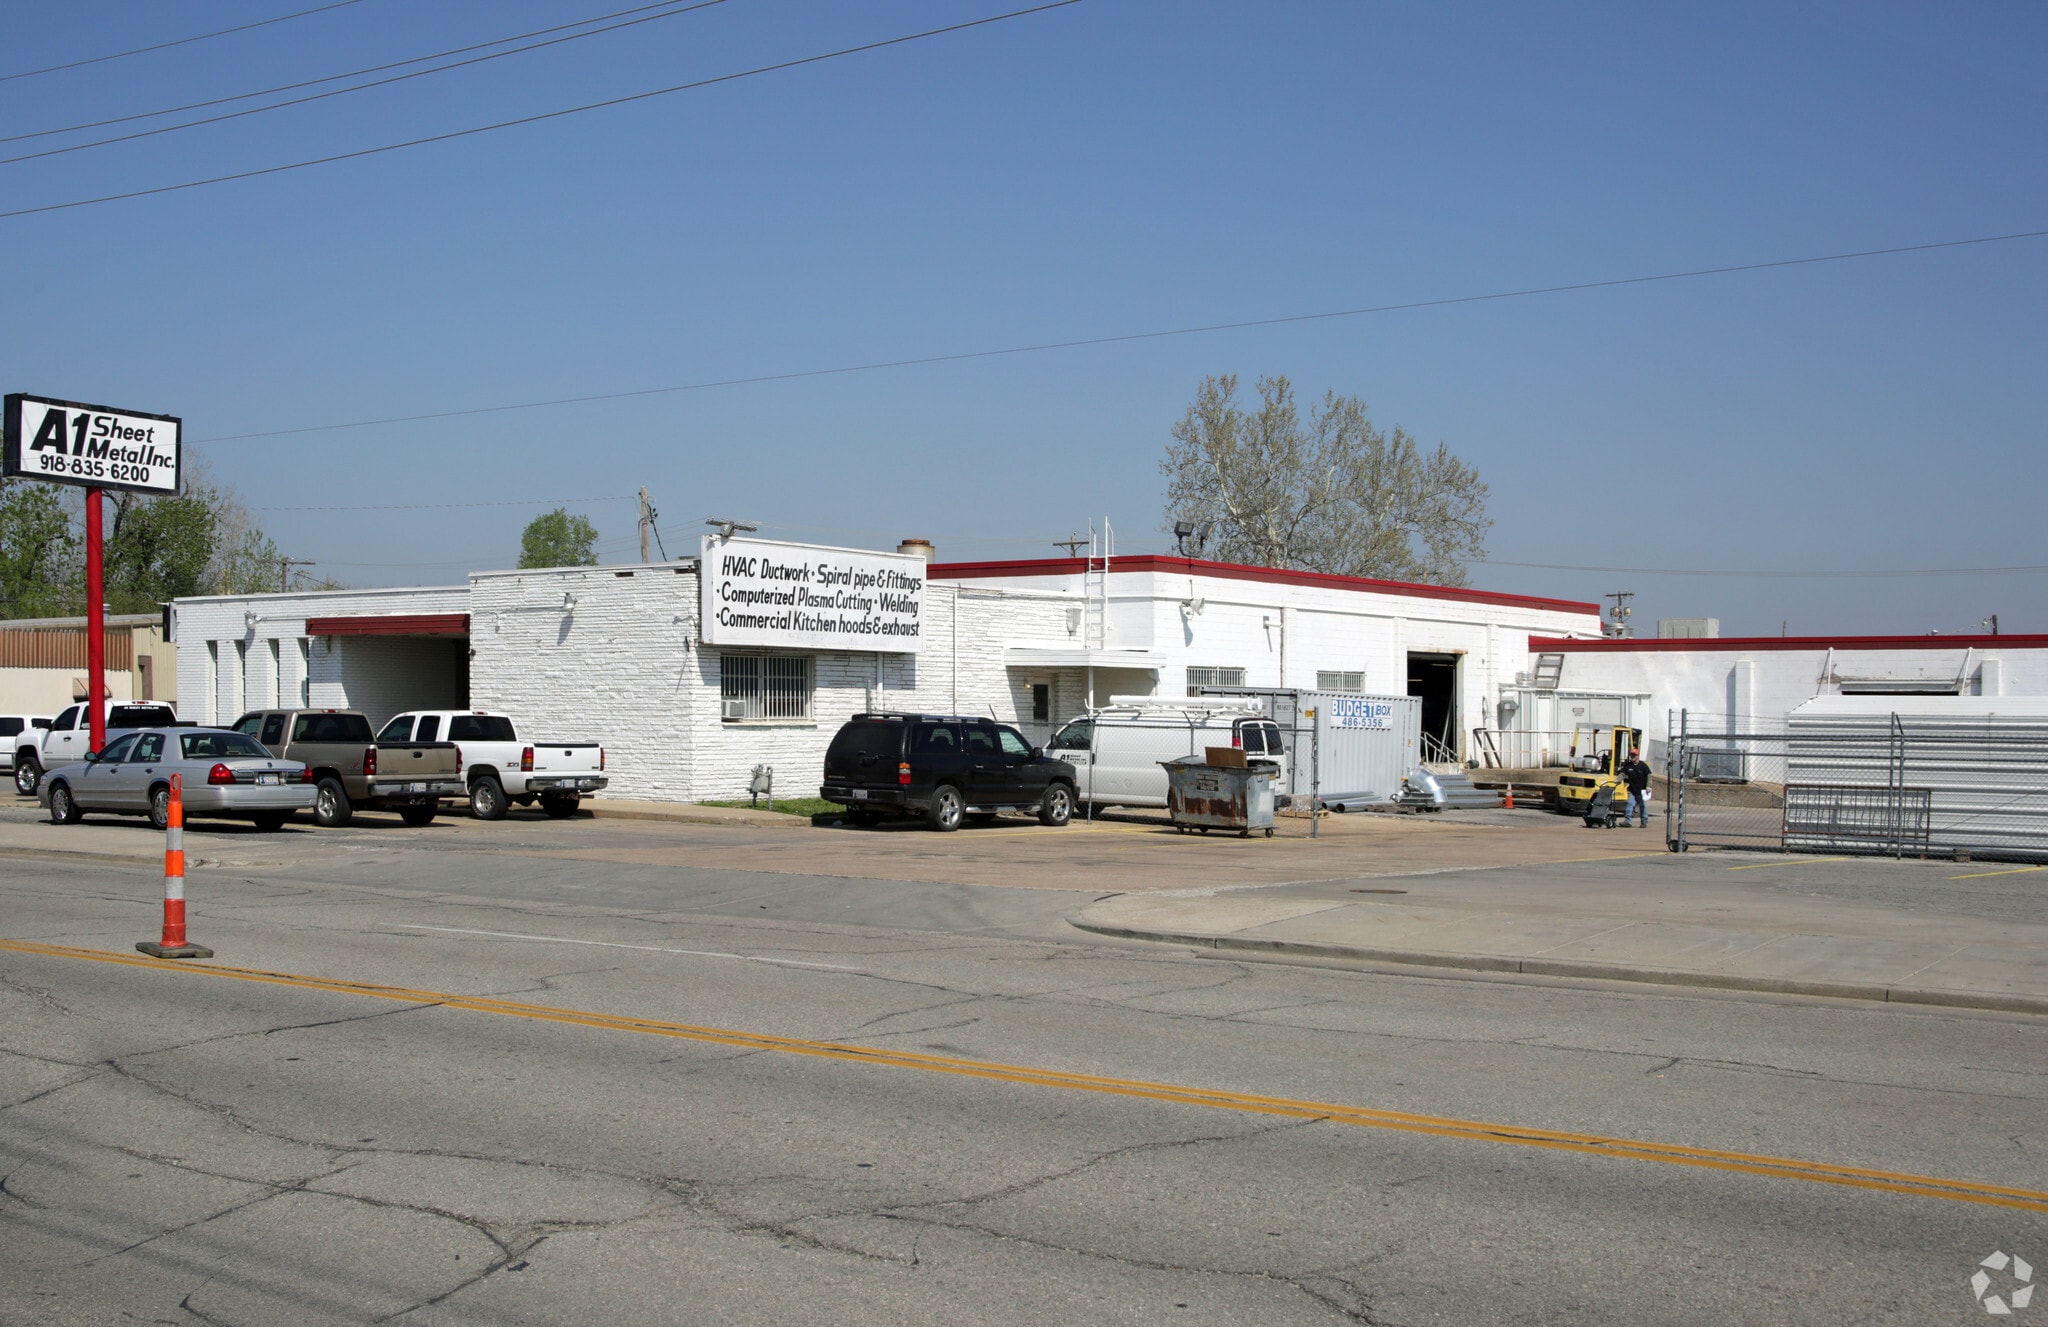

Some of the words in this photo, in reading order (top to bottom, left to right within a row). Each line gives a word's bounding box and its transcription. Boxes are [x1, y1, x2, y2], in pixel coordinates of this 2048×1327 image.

[30, 408, 91, 457] A1
[91, 415, 155, 443] Sheet
[721, 555, 757, 578] HVAC
[760, 558, 810, 582] Ductwork
[817, 563, 853, 588] Spiral
[853, 568, 875, 591] pipe
[721, 581, 796, 607] Computerized
[797, 586, 834, 608] Plasma
[835, 589, 872, 615] Cutting
[879, 592, 919, 618] Welding
[720, 606, 792, 630] Commercial
[793, 610, 836, 633] Kitchen
[1331, 699, 1374, 717] BUDGET
[1375, 704, 1392, 716] BOX
